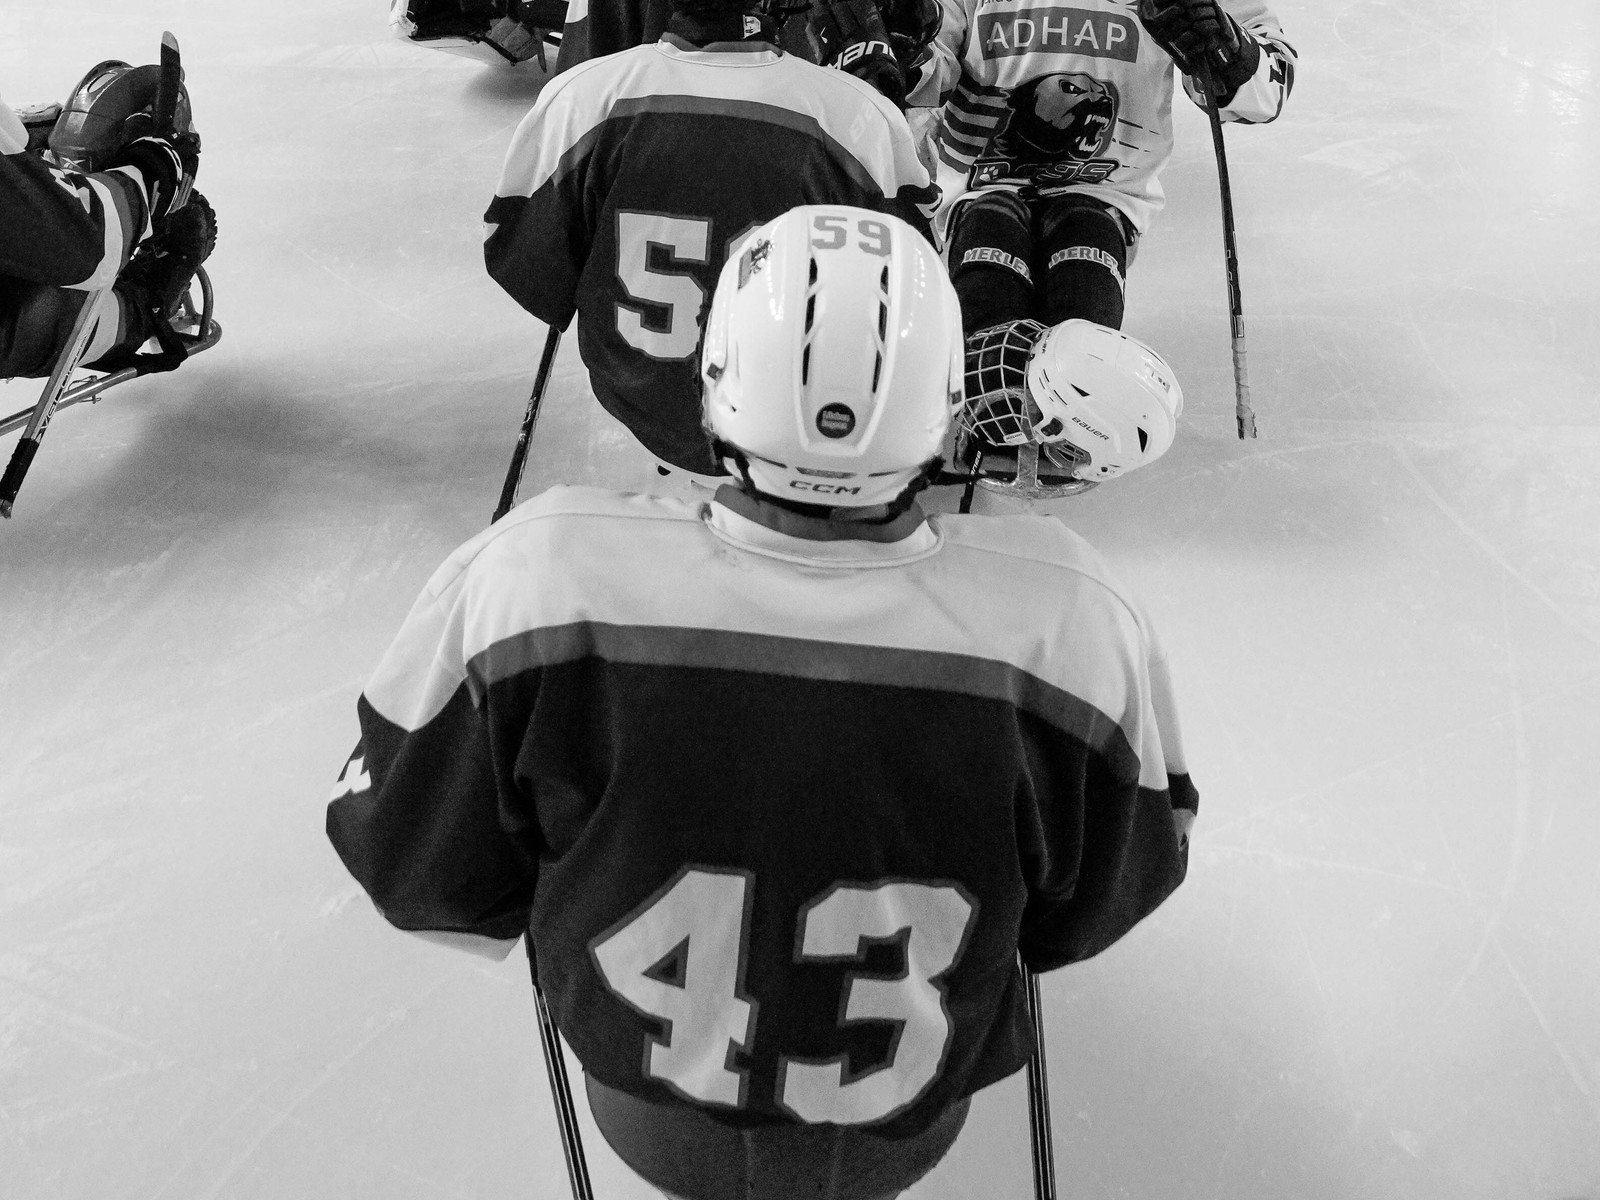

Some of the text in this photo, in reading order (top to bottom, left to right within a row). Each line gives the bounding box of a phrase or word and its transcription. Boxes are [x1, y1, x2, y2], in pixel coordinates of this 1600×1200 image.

[986, 16, 1128, 52] ADHAP
[811, 215, 892, 257] 59
[789, 480, 862, 496] CCM
[592, 866, 978, 1125] 43
